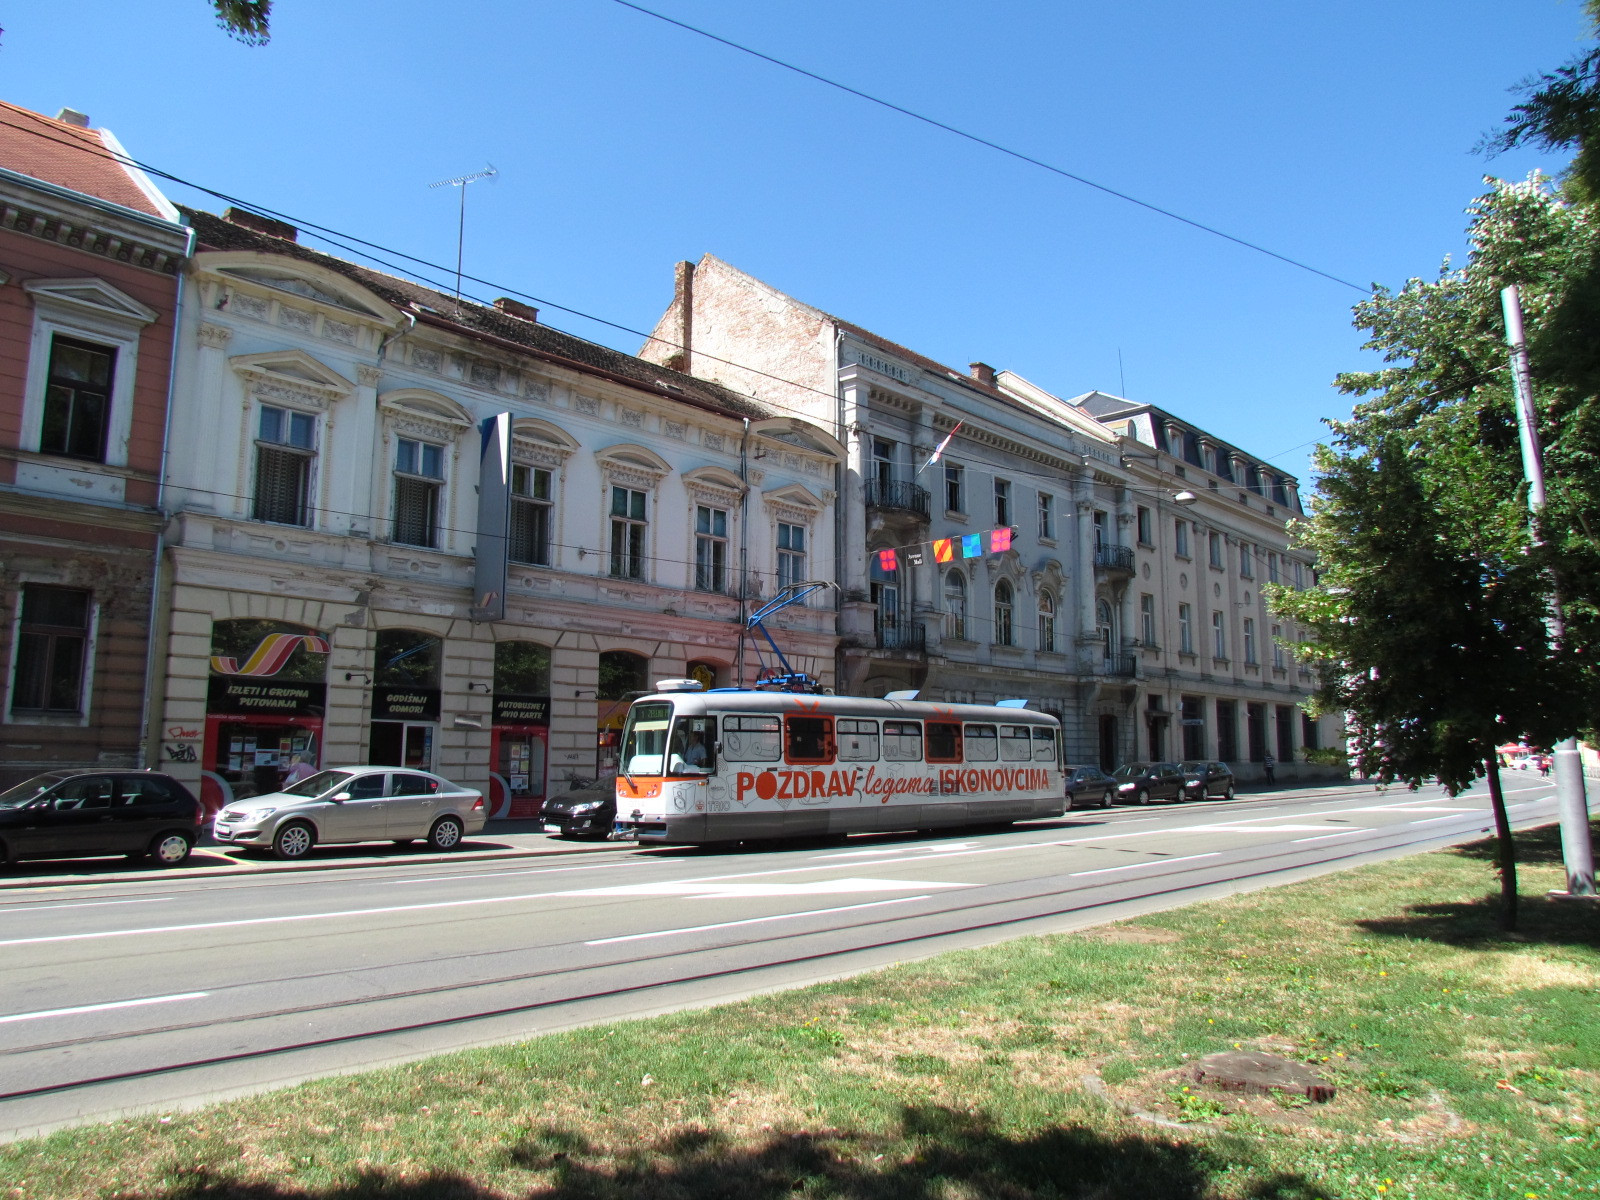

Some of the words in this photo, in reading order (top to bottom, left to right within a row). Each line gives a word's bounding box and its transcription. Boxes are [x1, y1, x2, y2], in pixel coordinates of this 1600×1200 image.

[227, 685, 261, 695] IZLETI
[261, 687, 268, 695] I
[269, 688, 309, 698] GRUPNA
[239, 697, 297, 708] PUTOVANJA
[386, 693, 428, 704] GODIŠNJI
[389, 705, 424, 713] ODMORI
[498, 701, 541, 710] AUTOBUSNE
[500, 711, 519, 719] AVIO
[519, 711, 543, 719] KARTE
[737, 770, 857, 800] POZDRAV
[863, 765, 934, 804] legama
[939, 768, 1049, 793] ISKONOVCIMA
